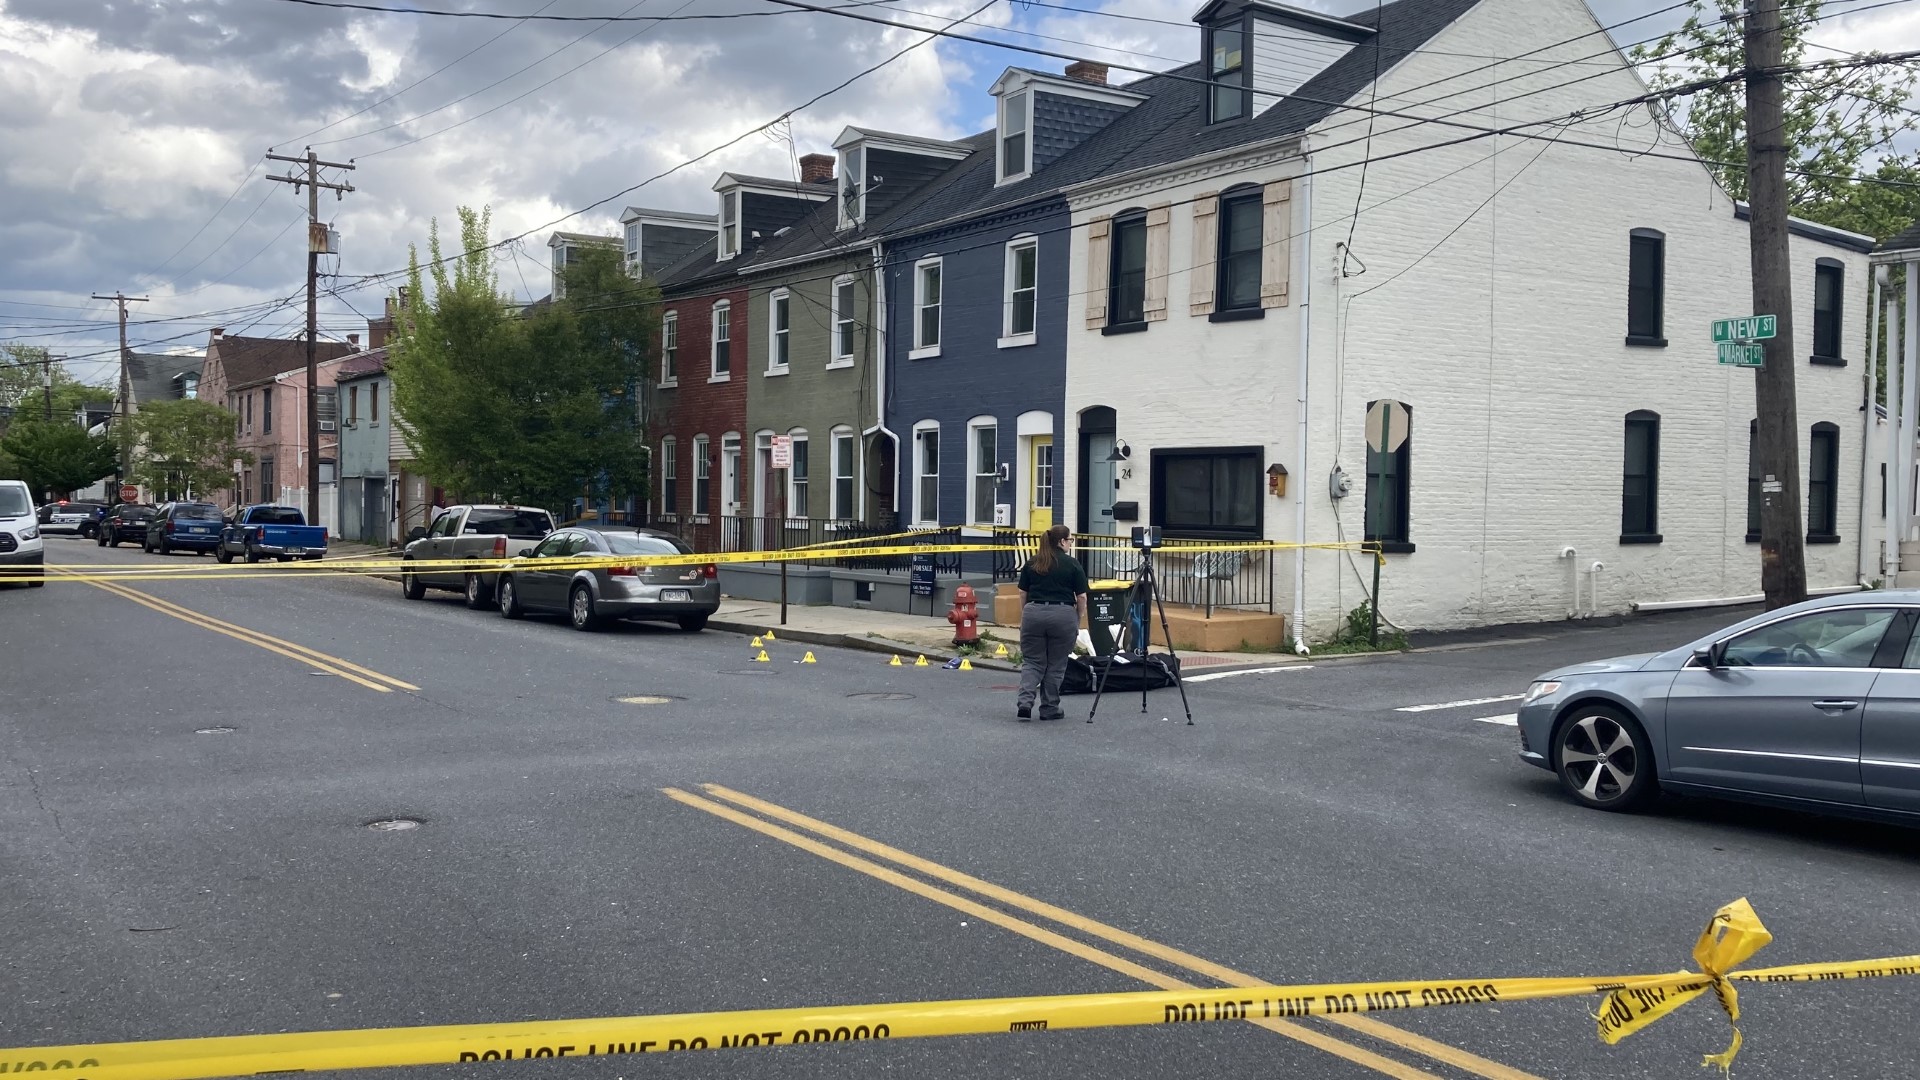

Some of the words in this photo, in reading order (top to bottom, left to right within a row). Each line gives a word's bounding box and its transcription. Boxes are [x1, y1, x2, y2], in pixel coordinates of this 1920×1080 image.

[1715, 322, 1723, 336] W
[1728, 318, 1760, 339] NEW
[1763, 317, 1773, 331] ST
[1724, 344, 1753, 363] MARKET
[1753, 346, 1761, 358] ST
[1121, 468, 1131, 480] 24
[121, 489, 138, 497] STOP
[996, 516, 1003, 524] 22
